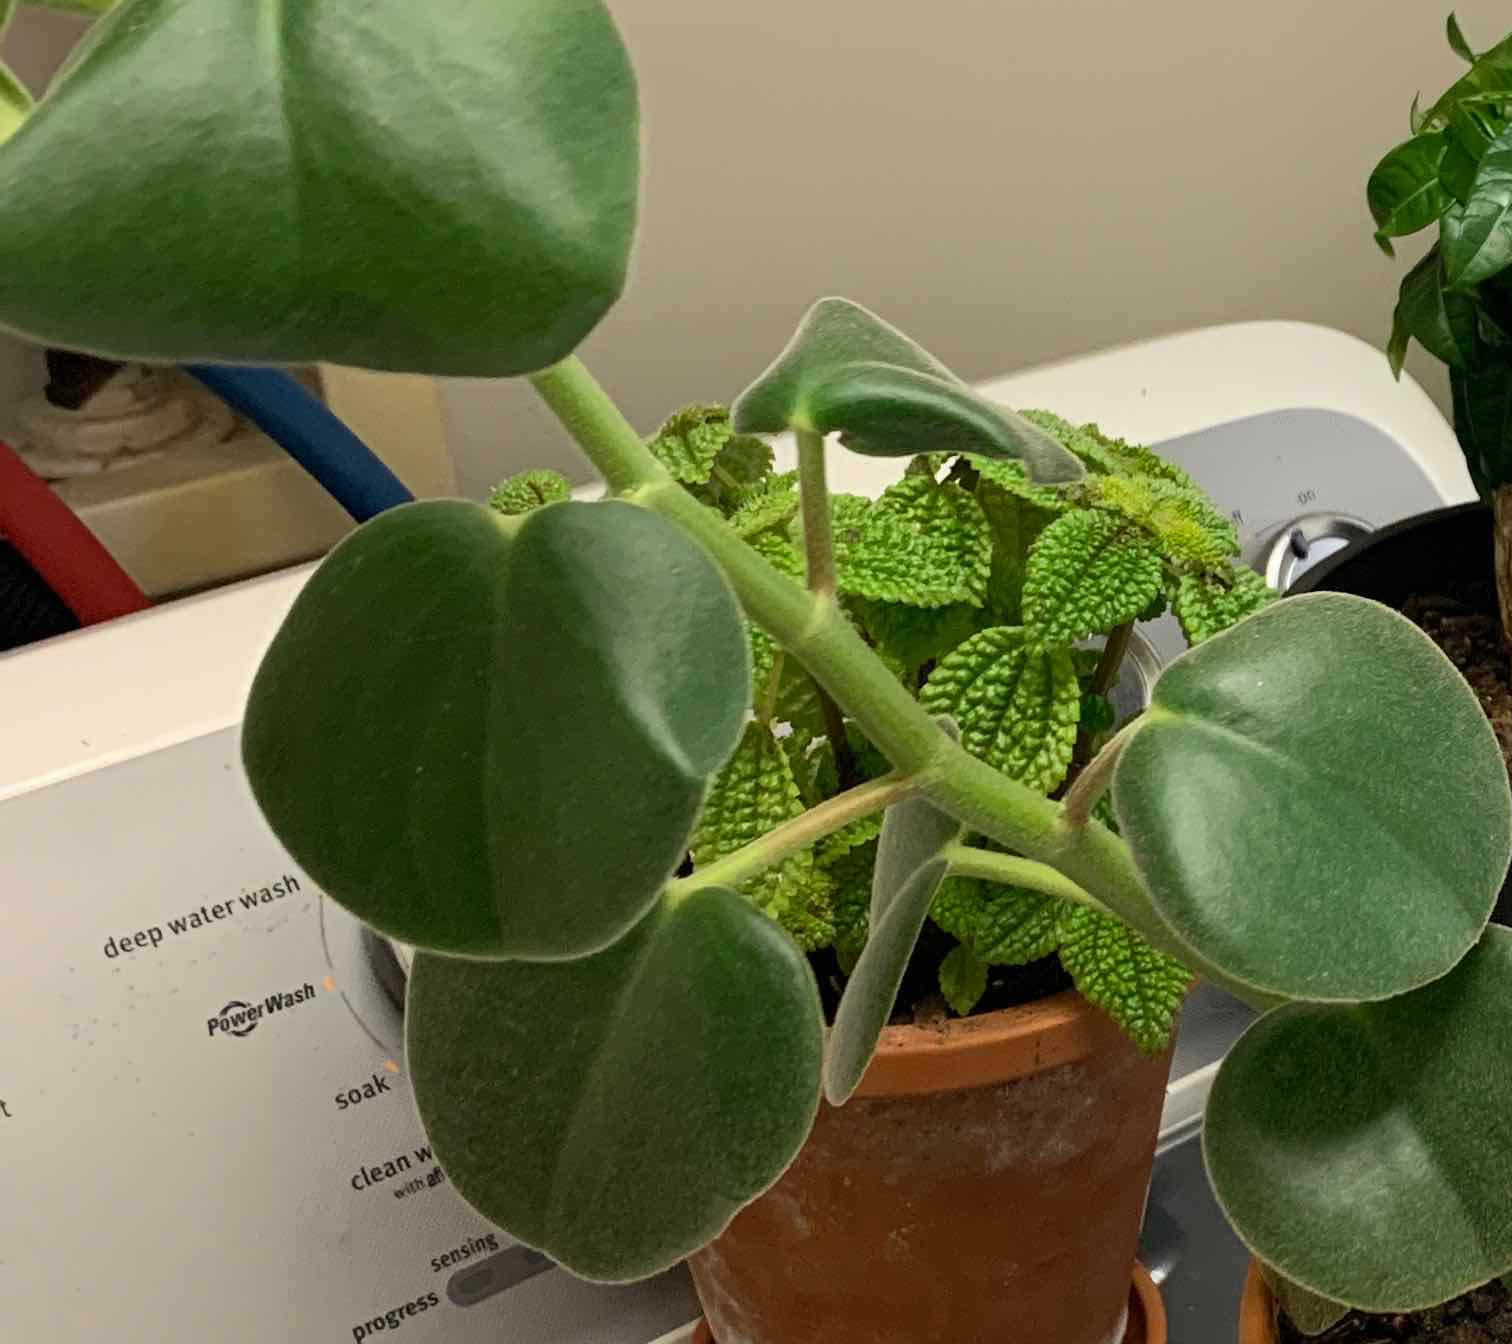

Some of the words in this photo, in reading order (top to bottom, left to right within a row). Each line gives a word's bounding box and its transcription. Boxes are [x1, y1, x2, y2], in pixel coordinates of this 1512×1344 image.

[103, 925, 163, 958] deep
[168, 899, 236, 935] water
[239, 874, 301, 910] wash
[207, 982, 317, 1037] PowerWash
[334, 1074, 391, 1110] soak
[351, 1155, 412, 1191] clean
[394, 1176, 426, 1200] with
[431, 1233, 499, 1272] sensing
[352, 1291, 440, 1344] progress
